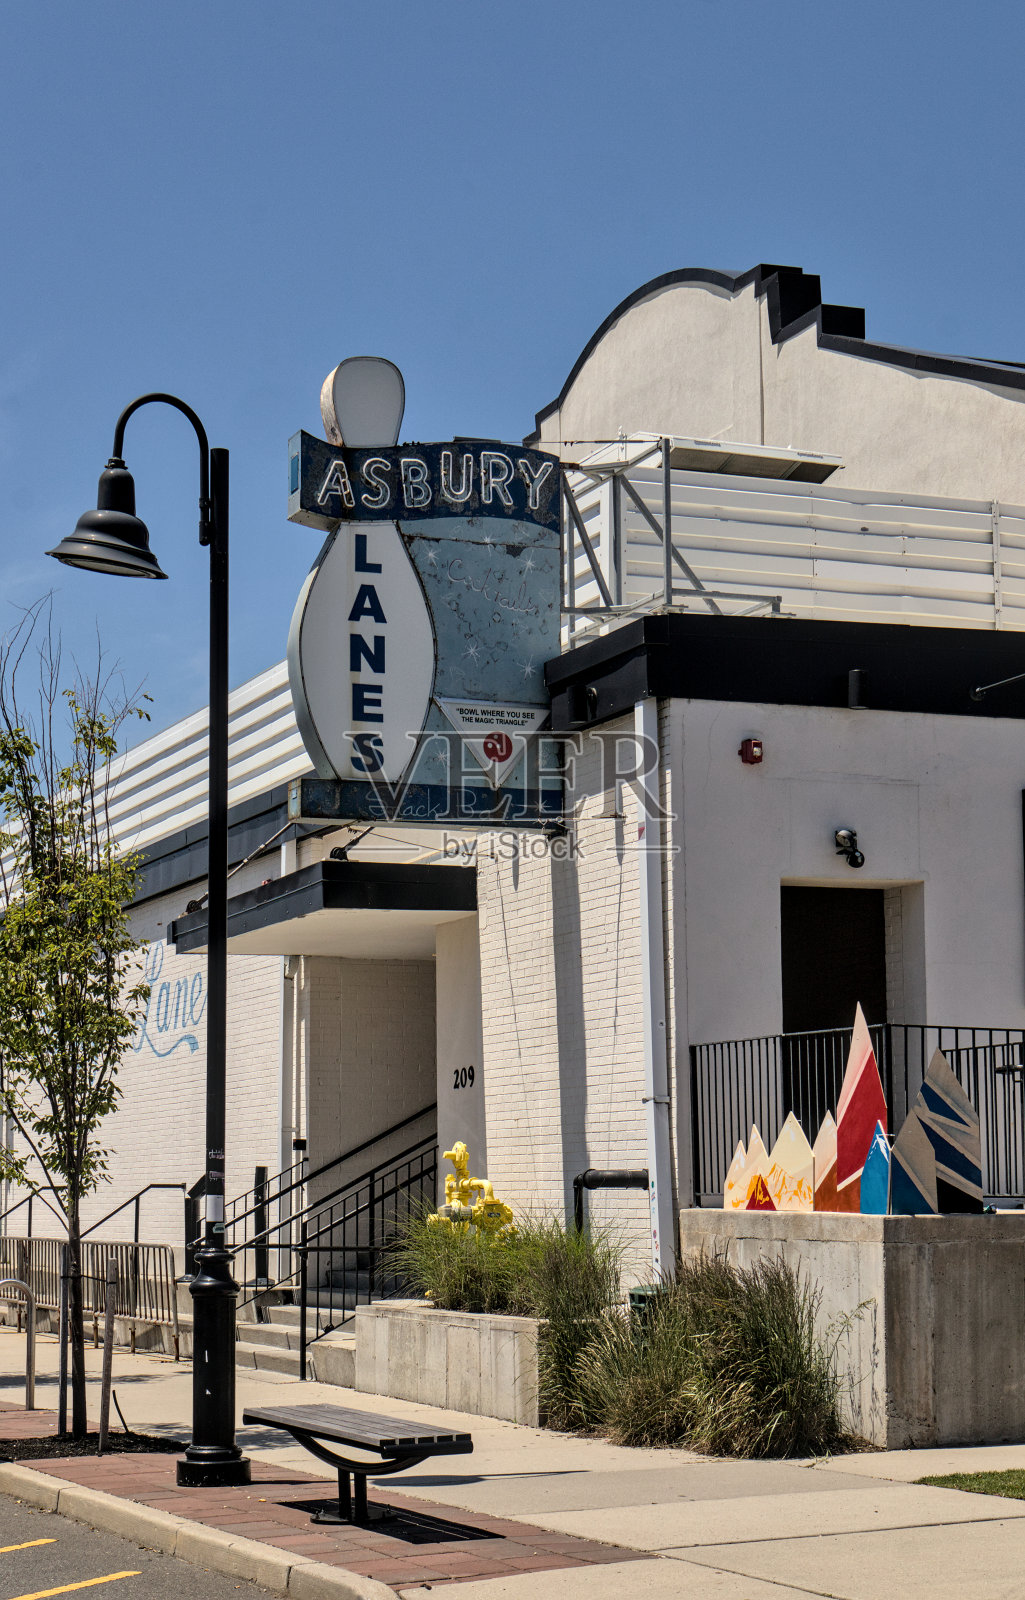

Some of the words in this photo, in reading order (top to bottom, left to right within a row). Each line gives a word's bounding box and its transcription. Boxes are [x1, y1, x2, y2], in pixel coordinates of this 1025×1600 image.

[317, 451, 554, 510] ASBURY
[347, 533, 388, 773] LANES
[474, 717, 495, 725] MAGIC
[480, 709, 505, 718] WHERE
[506, 711, 521, 719] YOU
[522, 712, 535, 720] SEE
[132, 940, 208, 1058] Lane
[453, 1065, 475, 1090] 209
